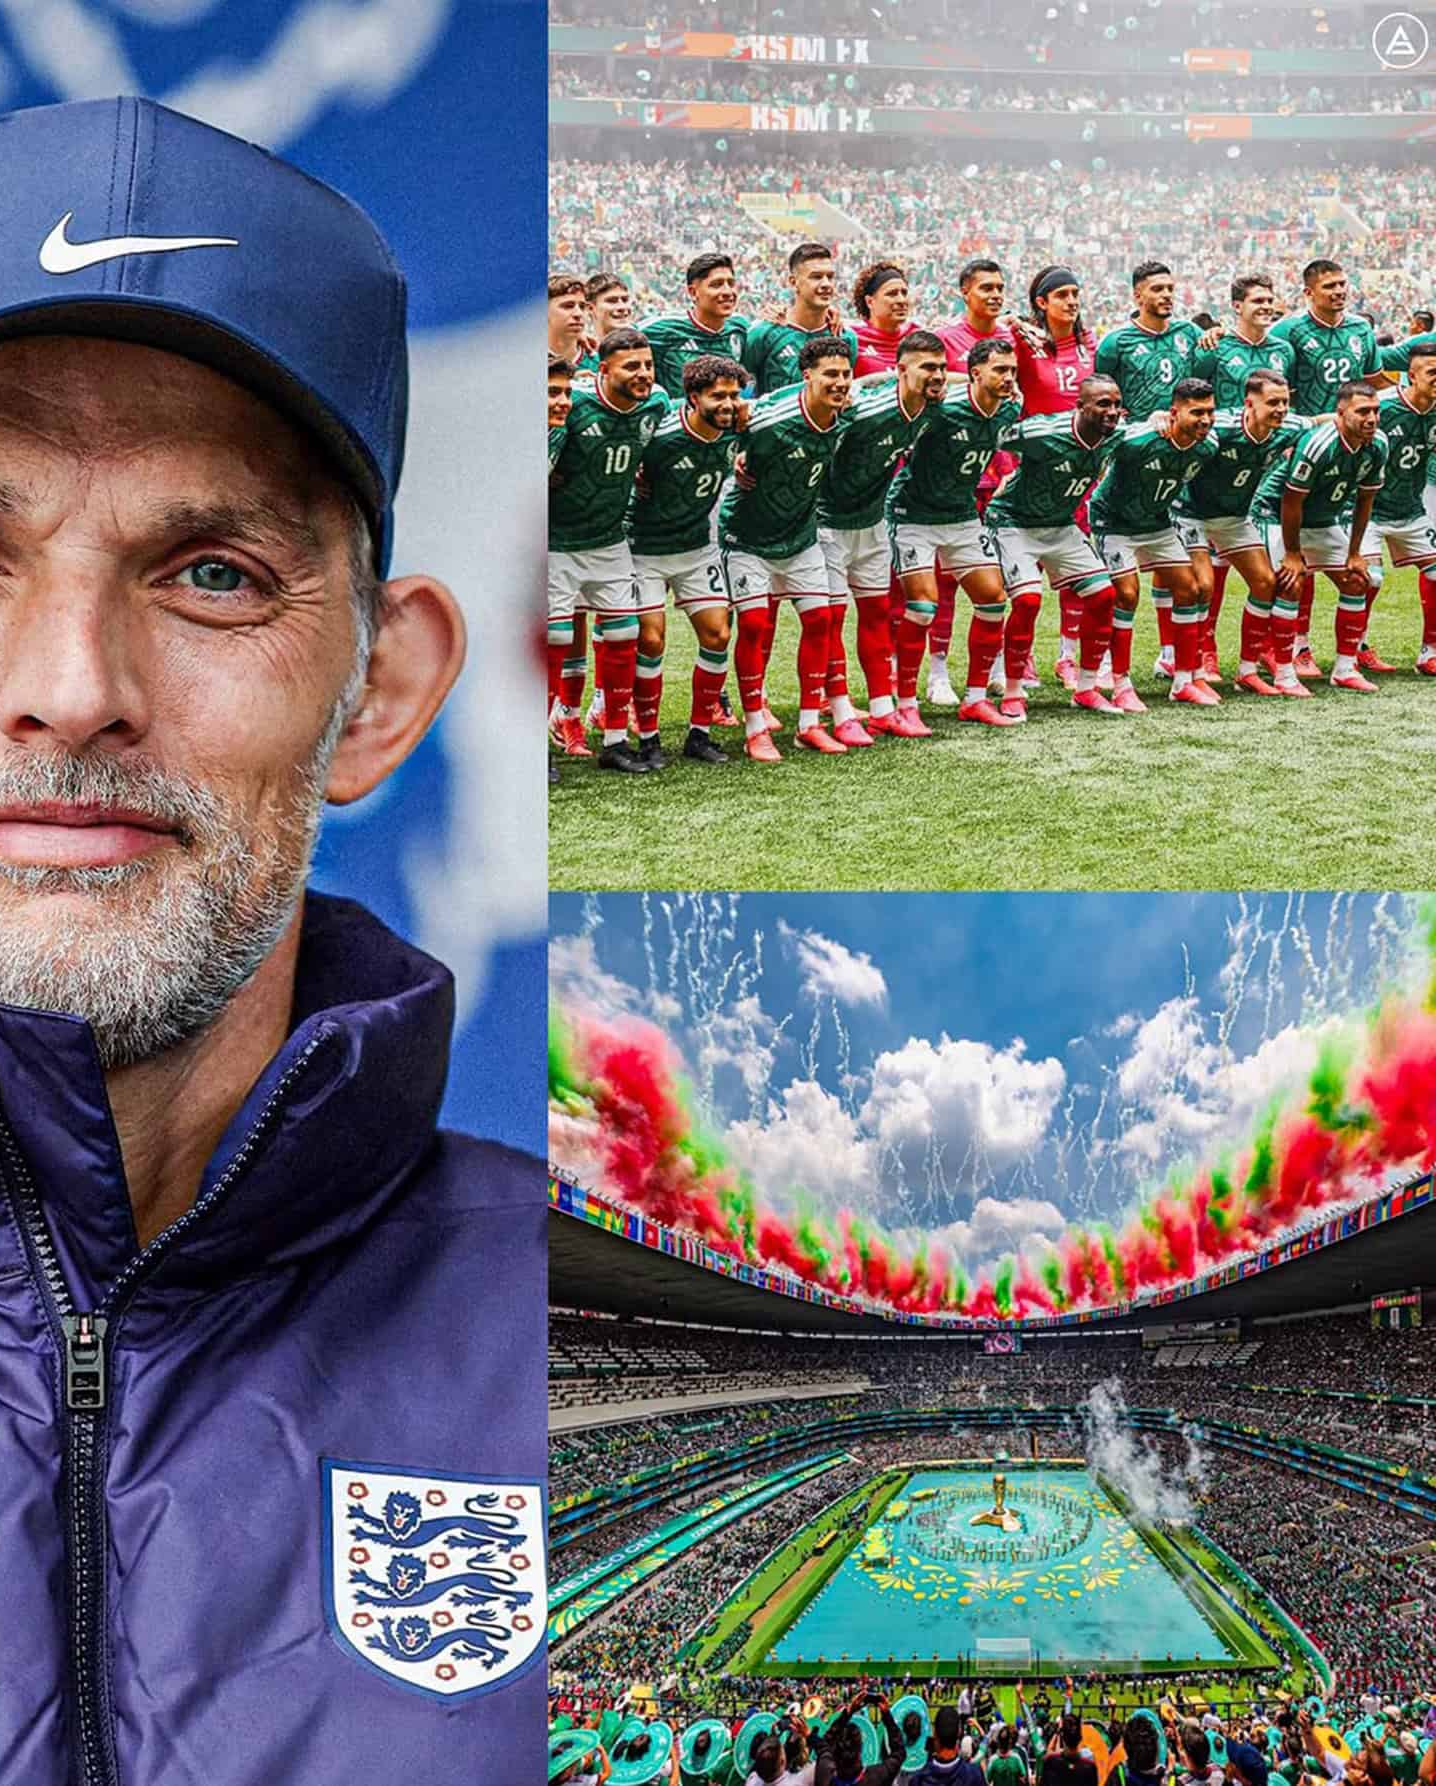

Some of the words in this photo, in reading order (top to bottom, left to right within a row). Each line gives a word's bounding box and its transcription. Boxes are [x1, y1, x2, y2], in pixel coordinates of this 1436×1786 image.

[1055, 366, 1079, 392] 12
[1159, 358, 1173, 383] 9
[1323, 358, 1351, 383] 22
[604, 445, 631, 475] 10
[960, 450, 993, 475] 24
[1399, 444, 1425, 469] 25
[695, 470, 723, 498] 21
[808, 462, 824, 488] 2
[1064, 476, 1092, 498] 16
[1233, 469, 1252, 487] 8
[1153, 479, 1177, 501] 17
[1330, 482, 1348, 502] 6
[548, 1553, 626, 1601] MEXICO
